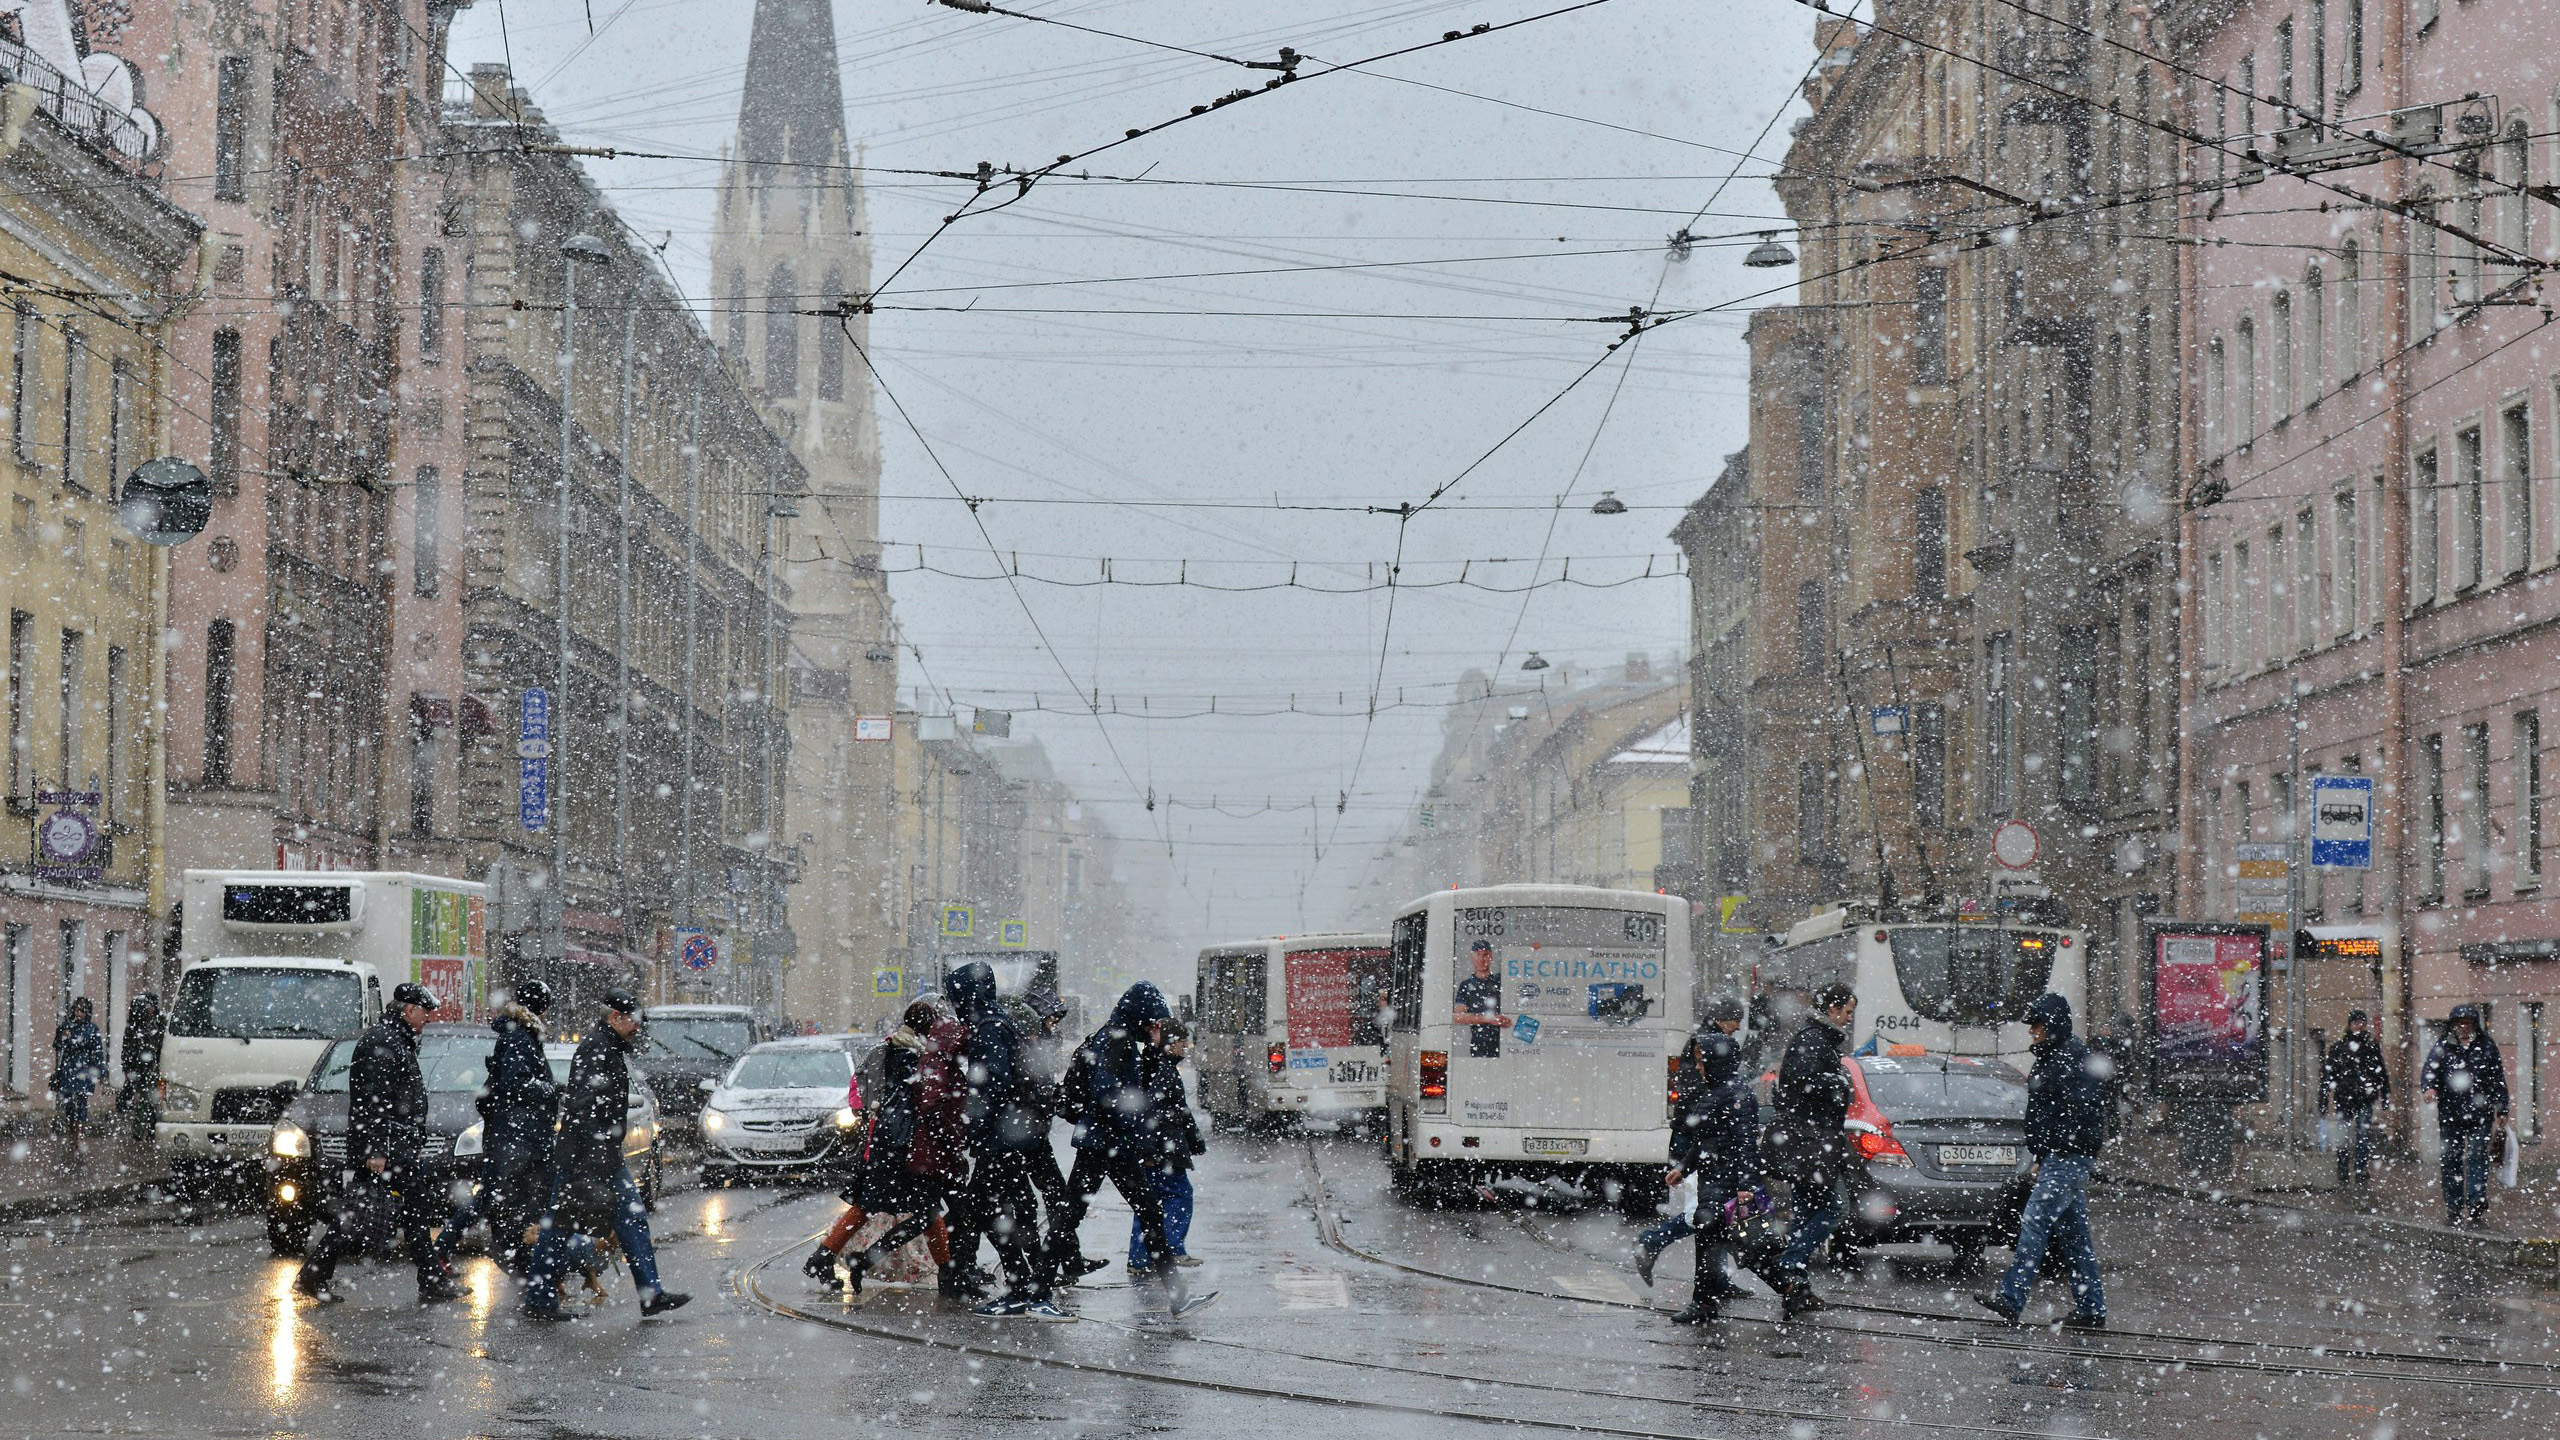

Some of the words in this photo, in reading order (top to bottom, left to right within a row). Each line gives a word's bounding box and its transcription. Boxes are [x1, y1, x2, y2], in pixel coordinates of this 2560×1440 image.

[1465, 909, 1505, 922] euro
[1465, 922, 1505, 936] auto
[1627, 918, 1656, 942] 30
[1589, 951, 1620, 959] Замена
[1621, 951, 1656, 960] колодок
[1507, 959, 1658, 980] БЕСПЛАТНО
[1876, 1015, 1920, 1030] 6844
